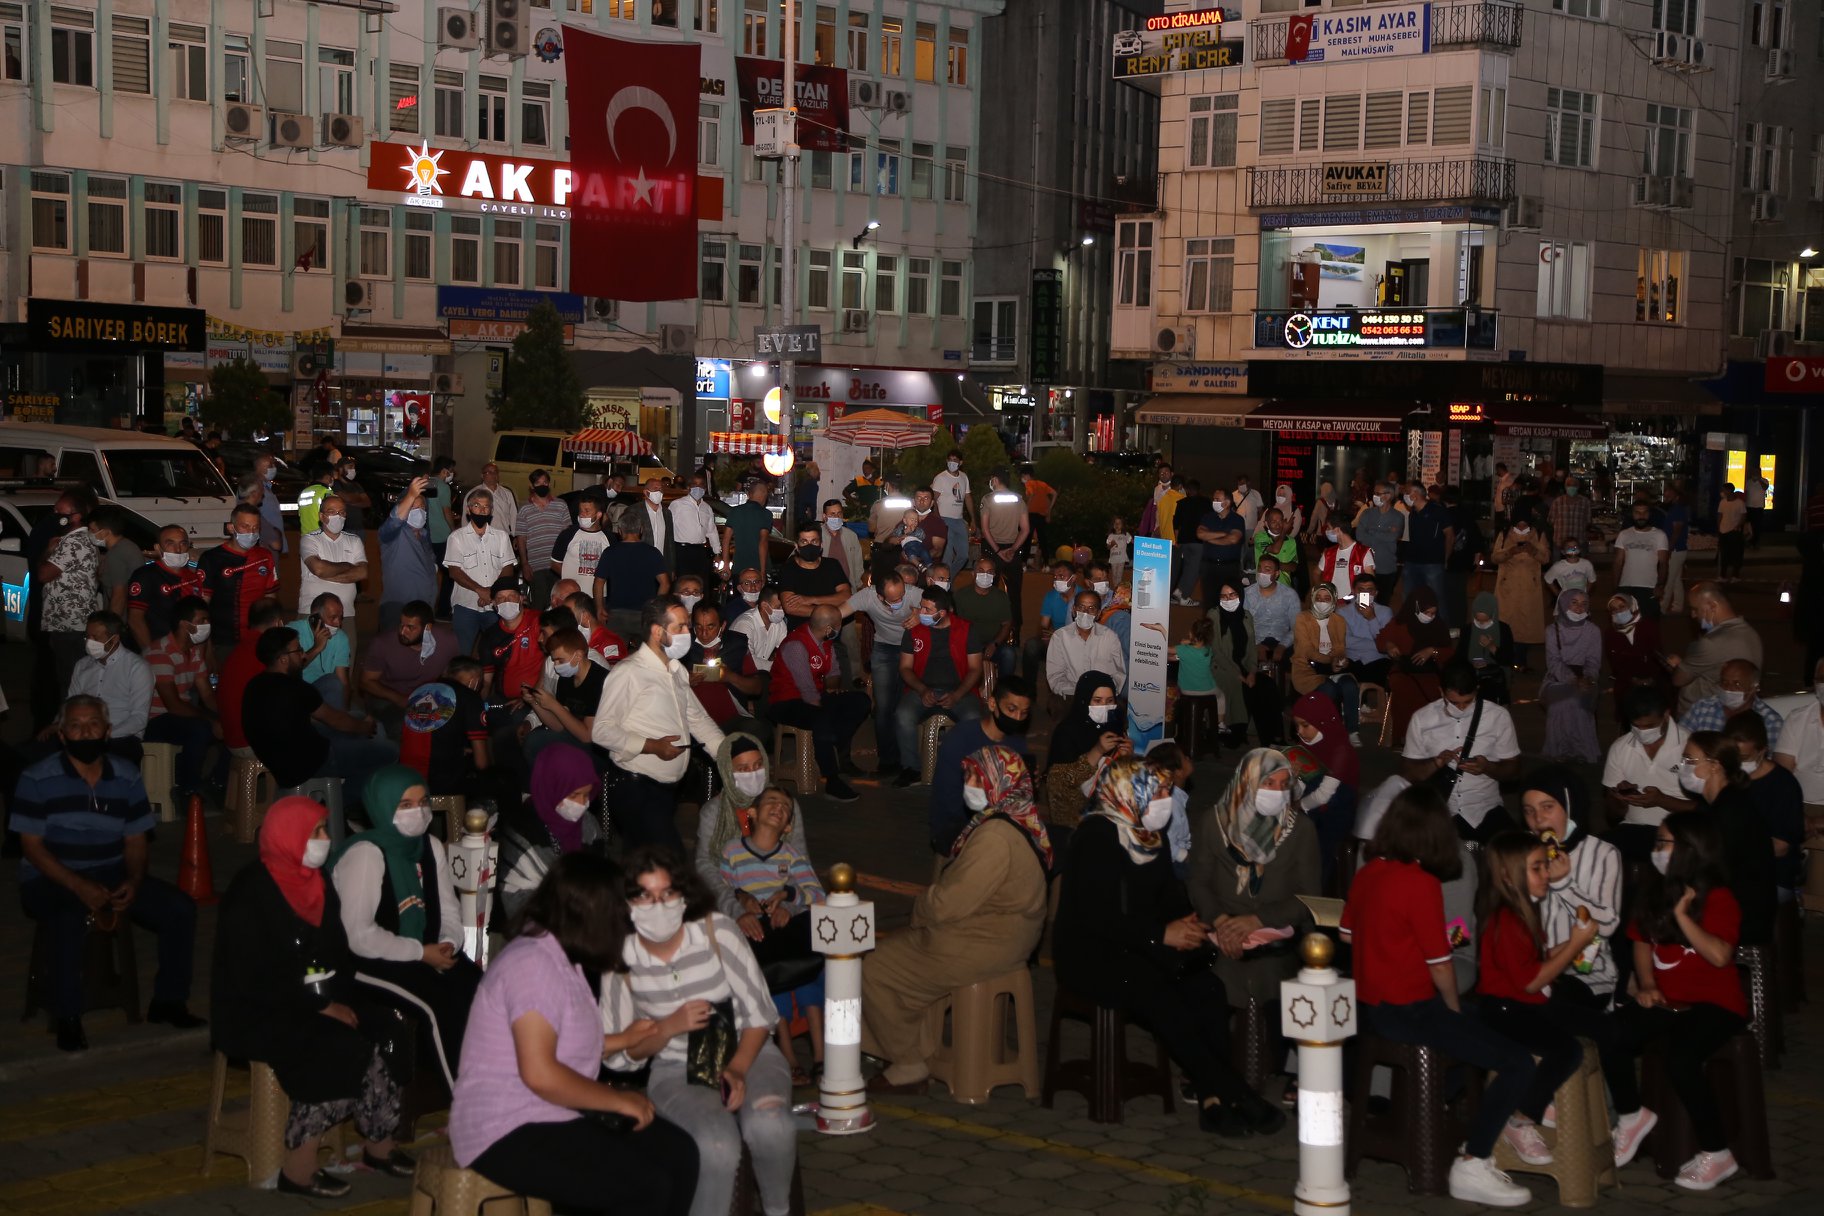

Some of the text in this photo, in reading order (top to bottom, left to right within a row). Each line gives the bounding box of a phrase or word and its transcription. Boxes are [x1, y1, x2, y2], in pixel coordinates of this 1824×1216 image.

[1148, 10, 1222, 30] OTO KİRALAMA
[1324, 11, 1416, 35] KASIM AYAR
[1162, 25, 1222, 52] ÇAYELİ
[1327, 29, 1420, 46] SERBEST MUHASEBECİ
[1341, 43, 1394, 56] MALİ MÜŞAVİR
[1127, 48, 1231, 75] RENT A CAR
[700, 77, 725, 96] DASI
[757, 76, 829, 101] DETAN
[797, 98, 829, 110] YAZILIR
[1326, 165, 1385, 180] AVUKAT
[460, 159, 535, 203] AK
[1326, 181, 1382, 192] Safiye BEYAZ
[480, 203, 535, 216] ÇAYELİ
[543, 207, 572, 221] İLÇ
[1262, 214, 1287, 226] KENT
[1366, 209, 1400, 222] EMLAK
[443, 305, 469, 317] ÇAYELİ
[1312, 316, 1350, 329] KENT
[1413, 315, 1424, 323] 53
[50, 315, 189, 345] SARIYER BÖREK
[478, 322, 498, 336] AK
[1361, 326, 1423, 335] 0542 065 66 53
[757, 332, 818, 354] EVET
[1311, 330, 1361, 346] TURİZM
[492, 359, 499, 372] P
[696, 379, 715, 393] orta
[795, 378, 887, 400] urak Büfe
[1189, 379, 1198, 388] AV
[8, 394, 61, 406] SARIYER
[592, 419, 629, 430] KUAFÖ
[1149, 415, 1180, 425] MERKEZ
[1263, 419, 1381, 432] MEYDAN KASAP ve TAVUKÇULUK
[1317, 431, 1345, 441] KASAP
[1509, 425, 1531, 436] MEYDAN
[1531, 426, 1552, 437] KASAP
[1559, 427, 1592, 439] TAVUKÇULUK
